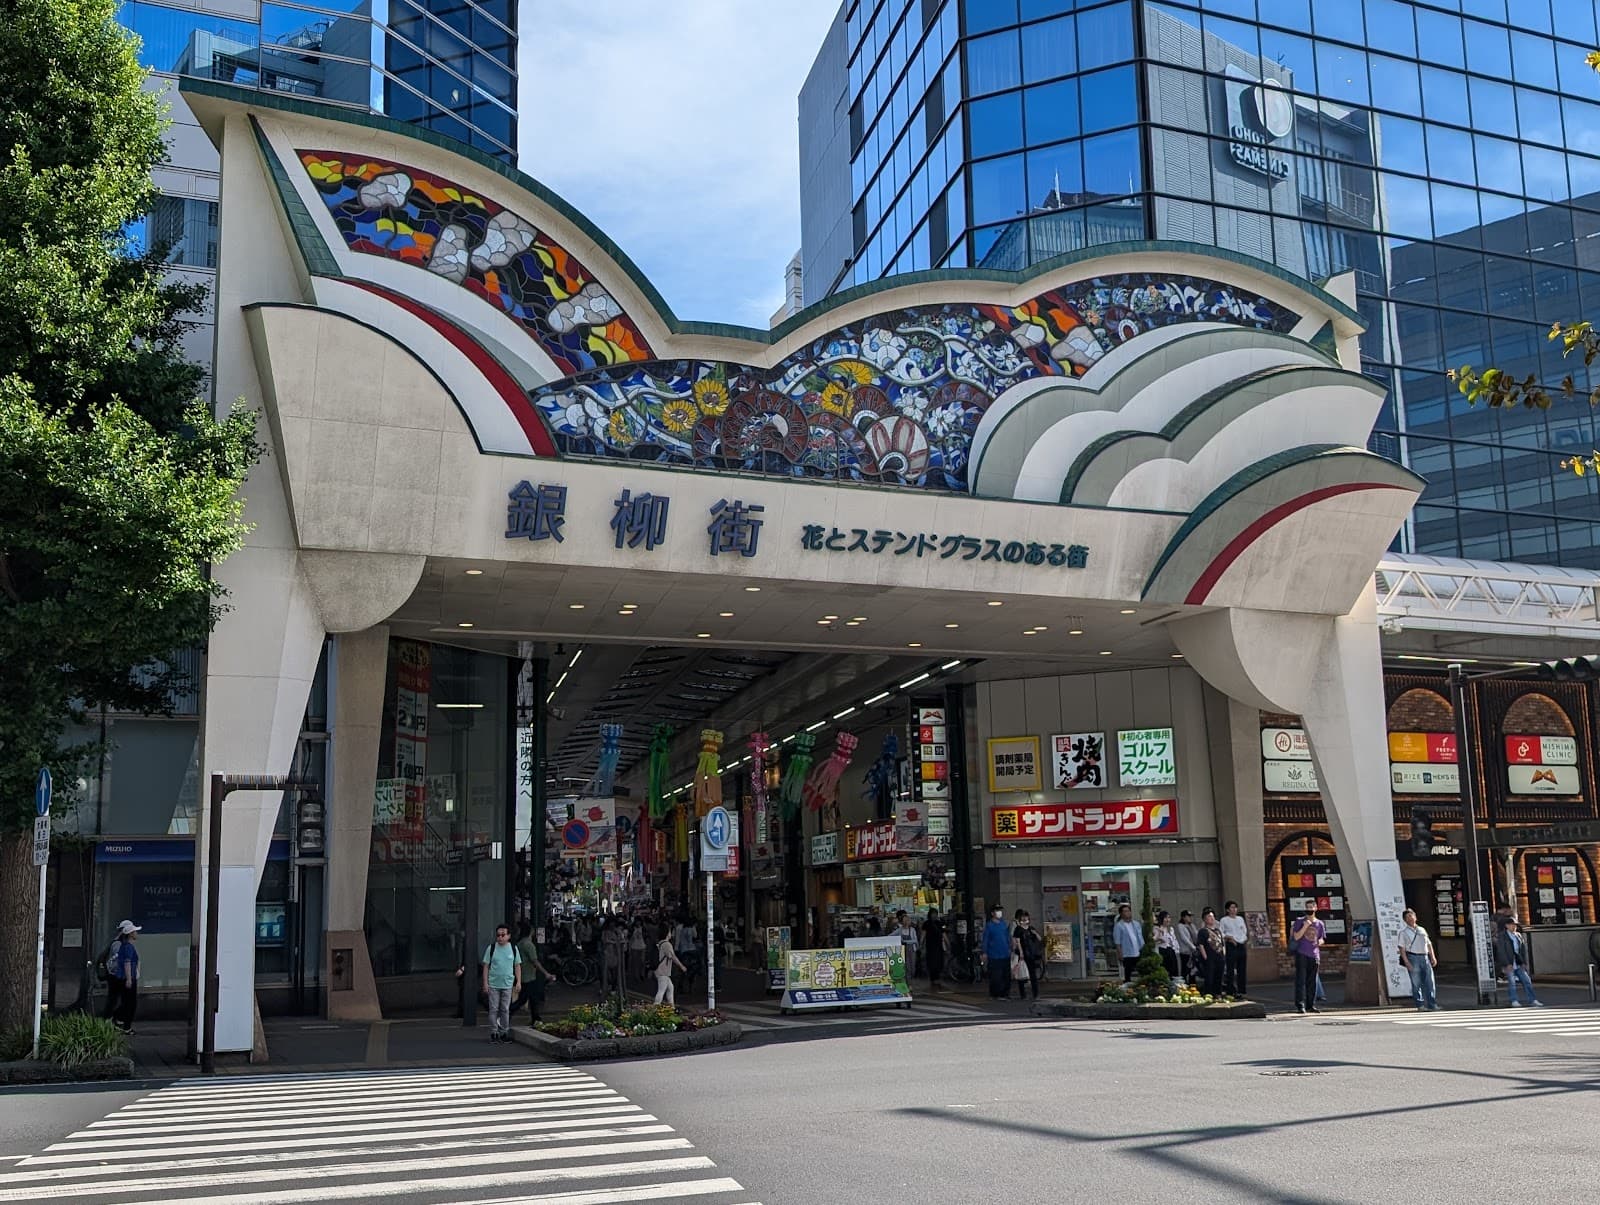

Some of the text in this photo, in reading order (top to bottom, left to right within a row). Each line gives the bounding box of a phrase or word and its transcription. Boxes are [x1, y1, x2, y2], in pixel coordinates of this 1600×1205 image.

[505, 479, 764, 558] 銀柳街
[801, 523, 1090, 569] 花とステンドグラスのある街
[1072, 735, 1103, 787] 焼肉
[1123, 742, 1167, 759] ゴルフ
[1059, 753, 1073, 788] きんぐ
[1121, 760, 1174, 776] スクール
[997, 806, 1145, 834] 薬 サンドラッグ
[143, 886, 183, 895] MIZUHO
